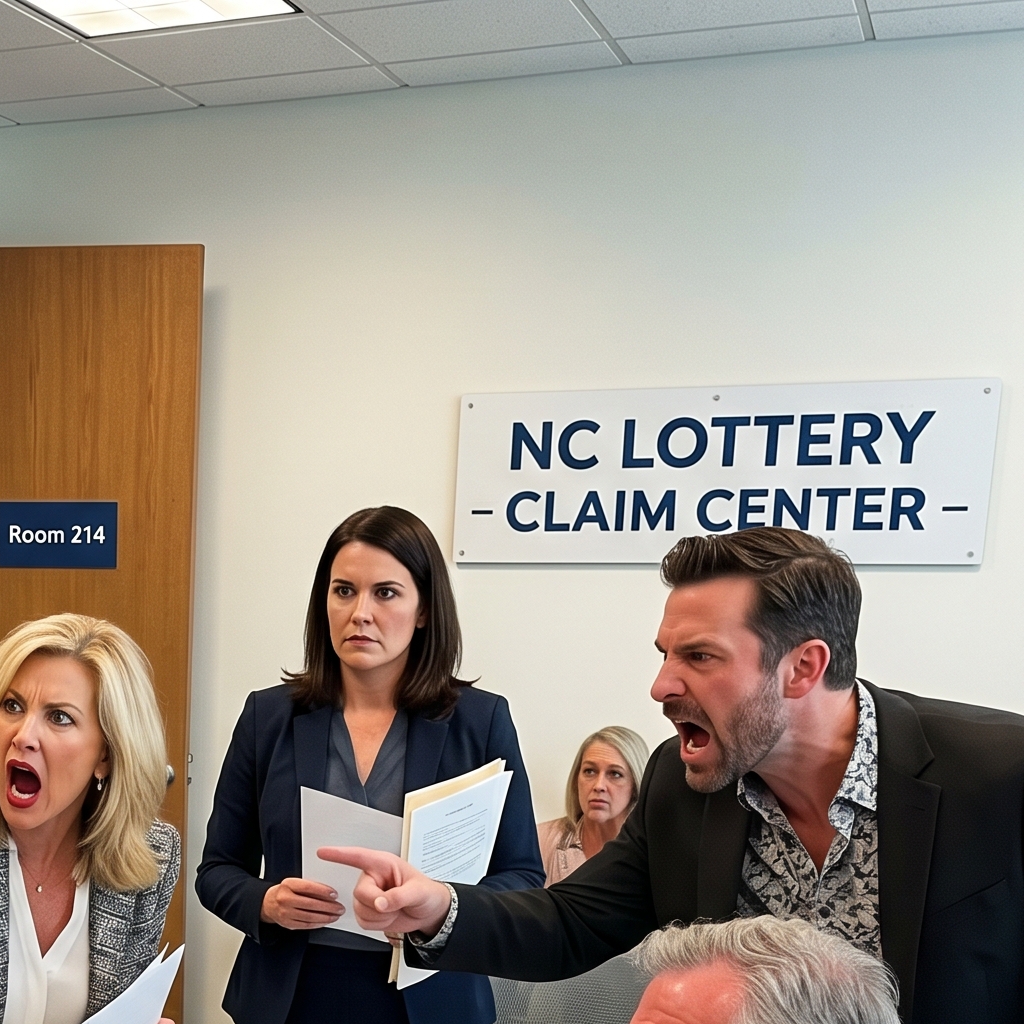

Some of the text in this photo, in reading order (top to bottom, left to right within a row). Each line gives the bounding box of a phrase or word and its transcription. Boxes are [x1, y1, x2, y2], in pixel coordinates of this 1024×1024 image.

[509, 410, 936, 471] NC LOTTERY
[506, 487, 925, 533] CLAIM CENTER
[9, 525, 105, 544] Room 214
